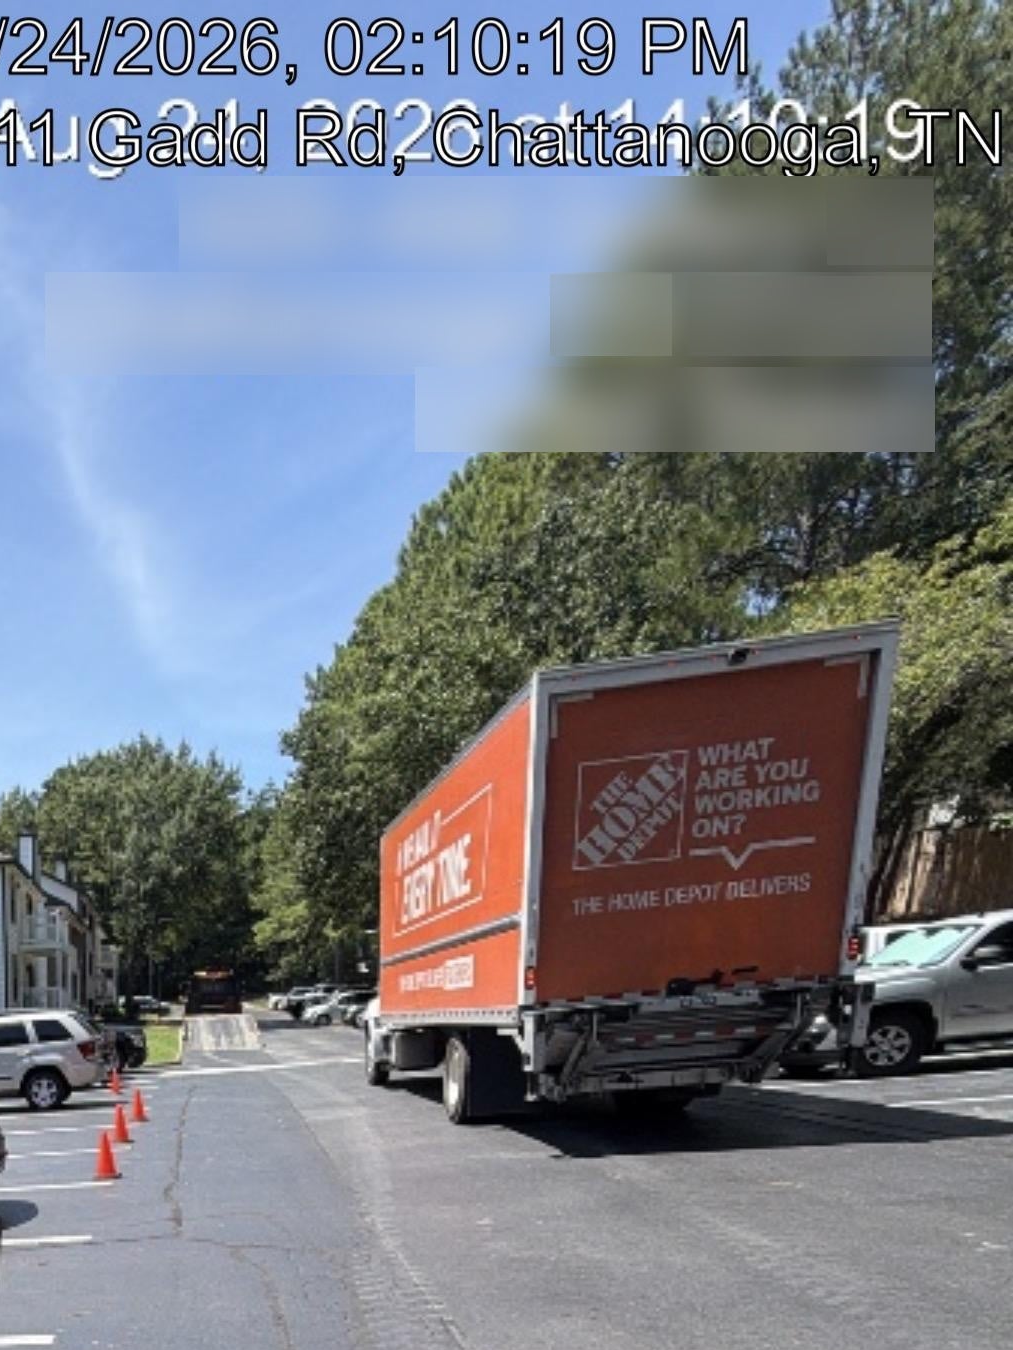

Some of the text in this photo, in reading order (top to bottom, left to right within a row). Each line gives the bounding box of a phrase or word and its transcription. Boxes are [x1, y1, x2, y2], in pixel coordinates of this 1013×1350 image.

[697, 737, 775, 767] WHAT
[590, 770, 633, 815] THE
[696, 758, 809, 791] ARE YOU
[577, 752, 687, 864] HOME
[694, 780, 820, 815] WORKING
[617, 791, 683, 862] DEPOT
[691, 815, 746, 838] ON?
[572, 873, 811, 916] THE HOME DEPOT DELIVERS
